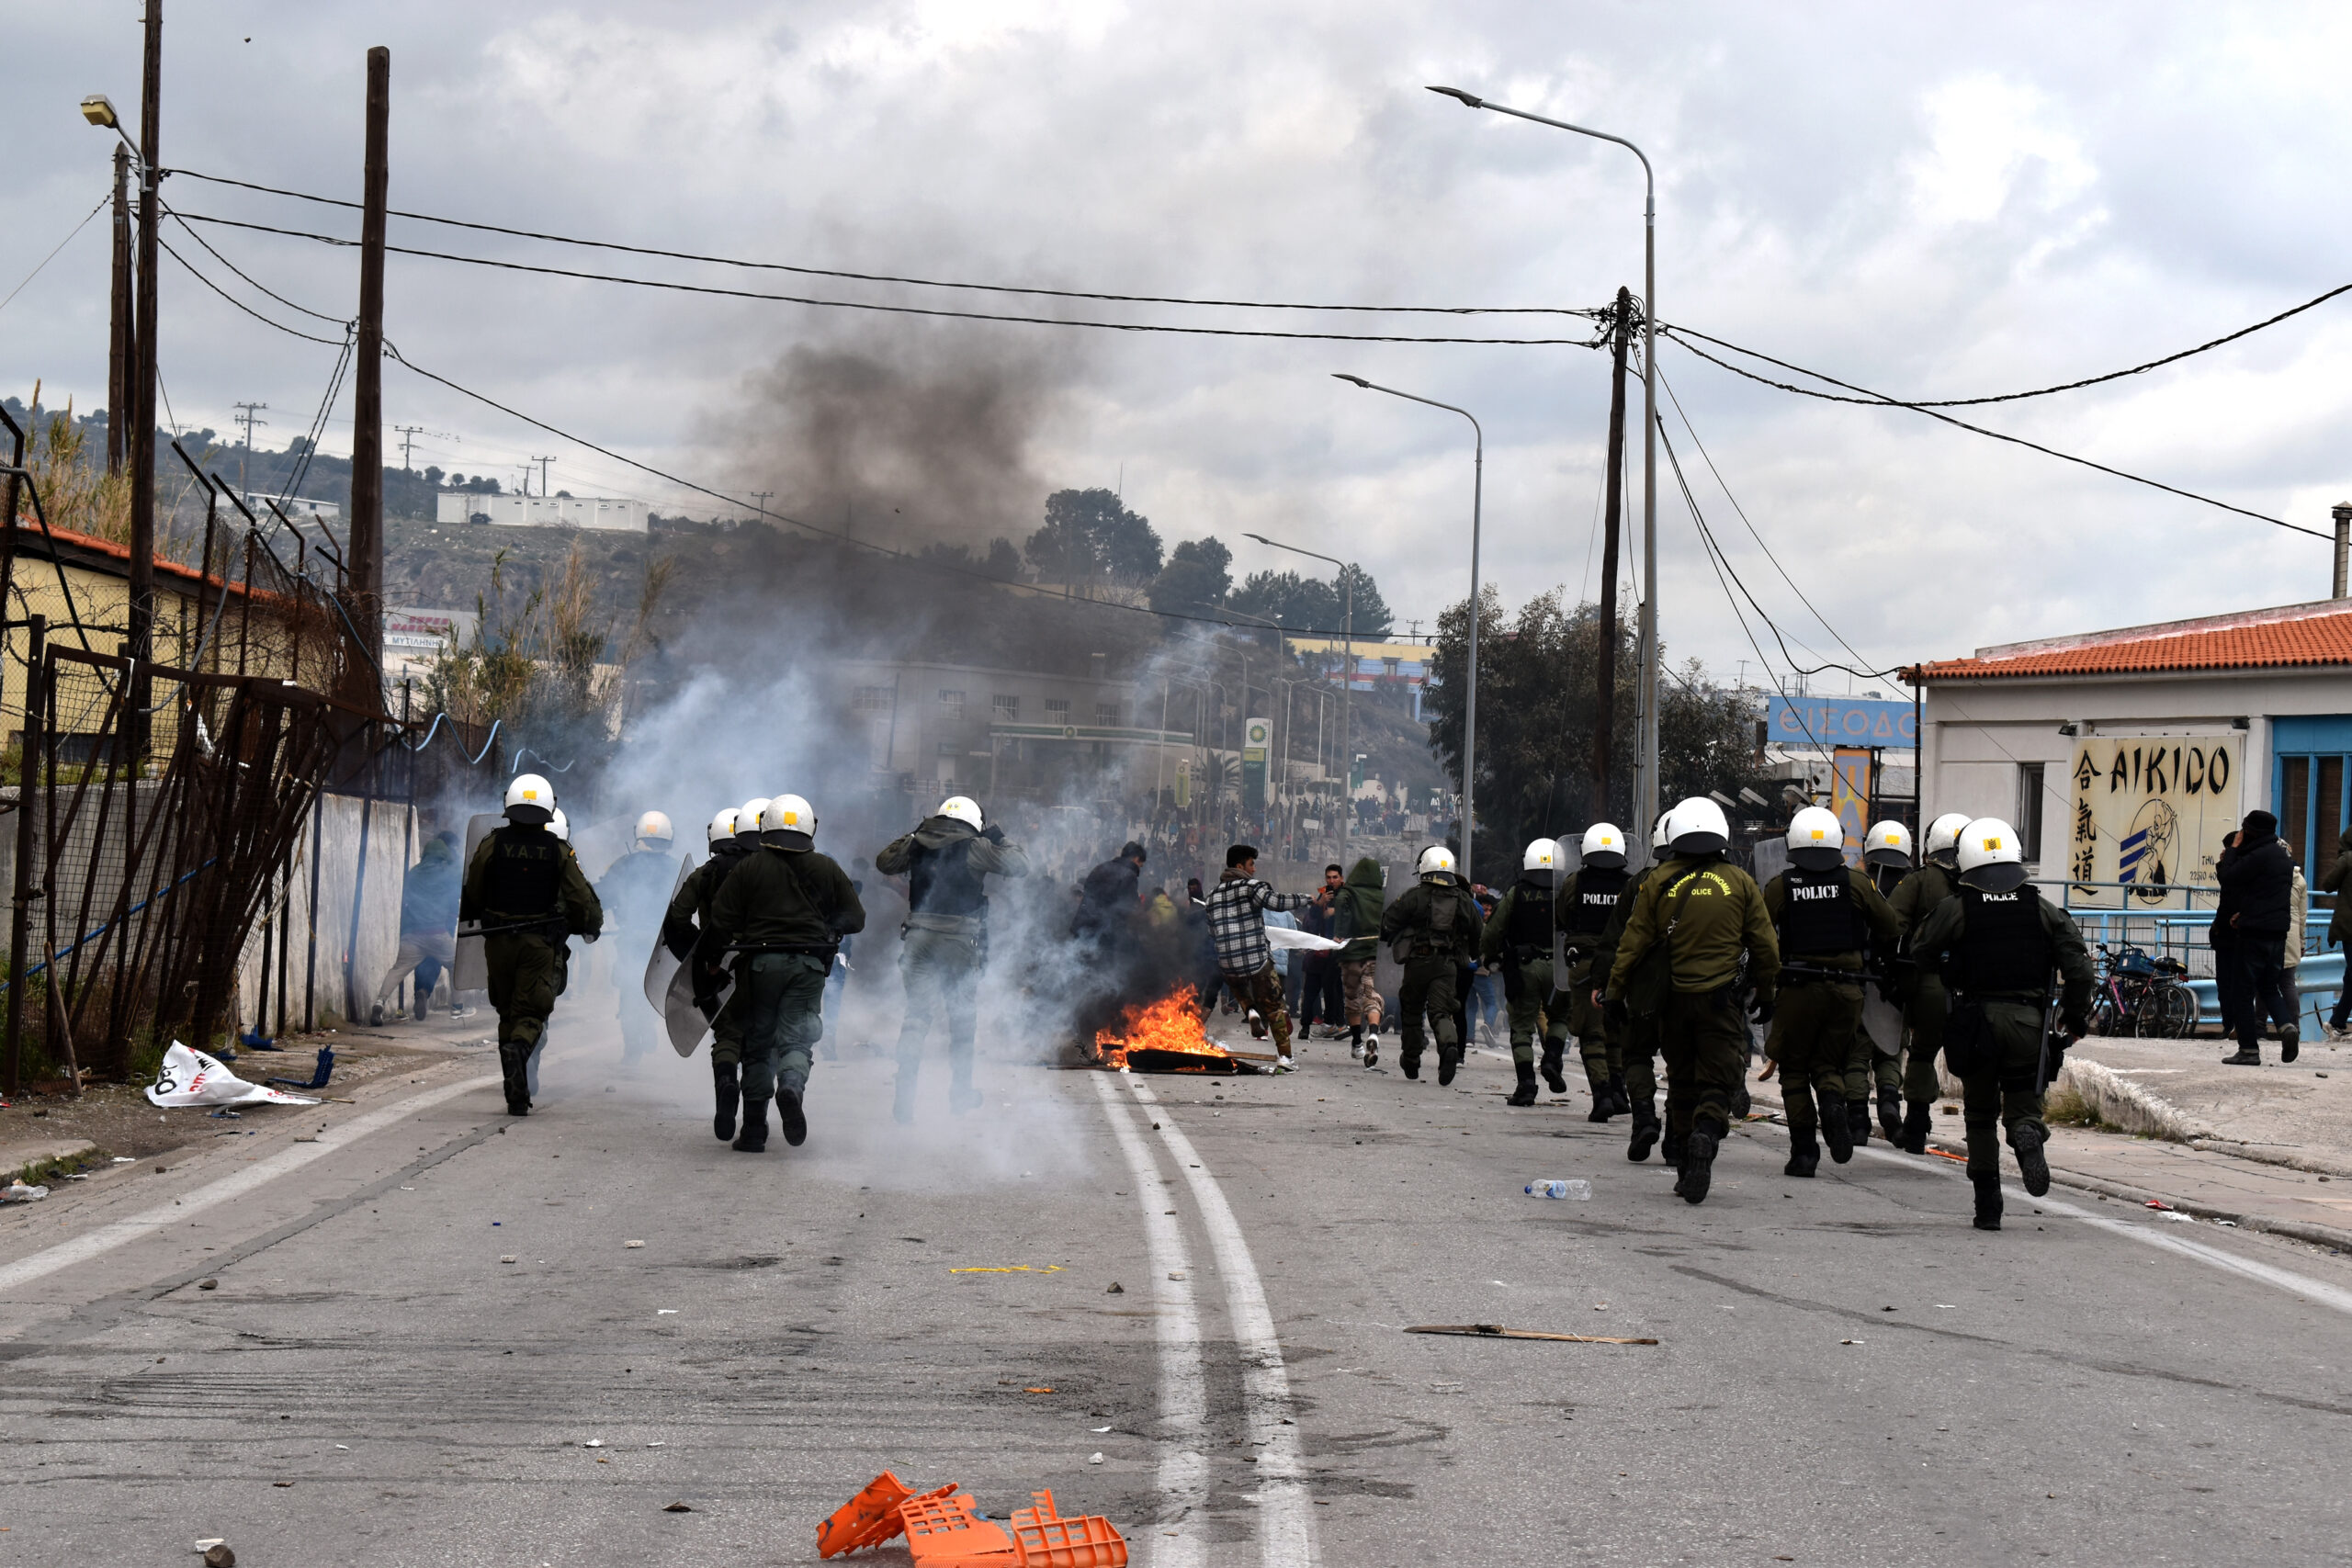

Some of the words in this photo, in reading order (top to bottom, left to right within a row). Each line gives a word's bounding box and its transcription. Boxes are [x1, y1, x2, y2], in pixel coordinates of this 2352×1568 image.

[1779, 706, 1927, 739] ΕΙΣΟΔΟ
[2110, 746, 2230, 795] AIKIDO
[2073, 749, 2102, 897] 合氣道
[1690, 887, 1713, 897] OLICE
[1701, 871, 1732, 897] ΣΤΥΝΟΜΙΑ
[1792, 885, 1840, 901] POLICE
